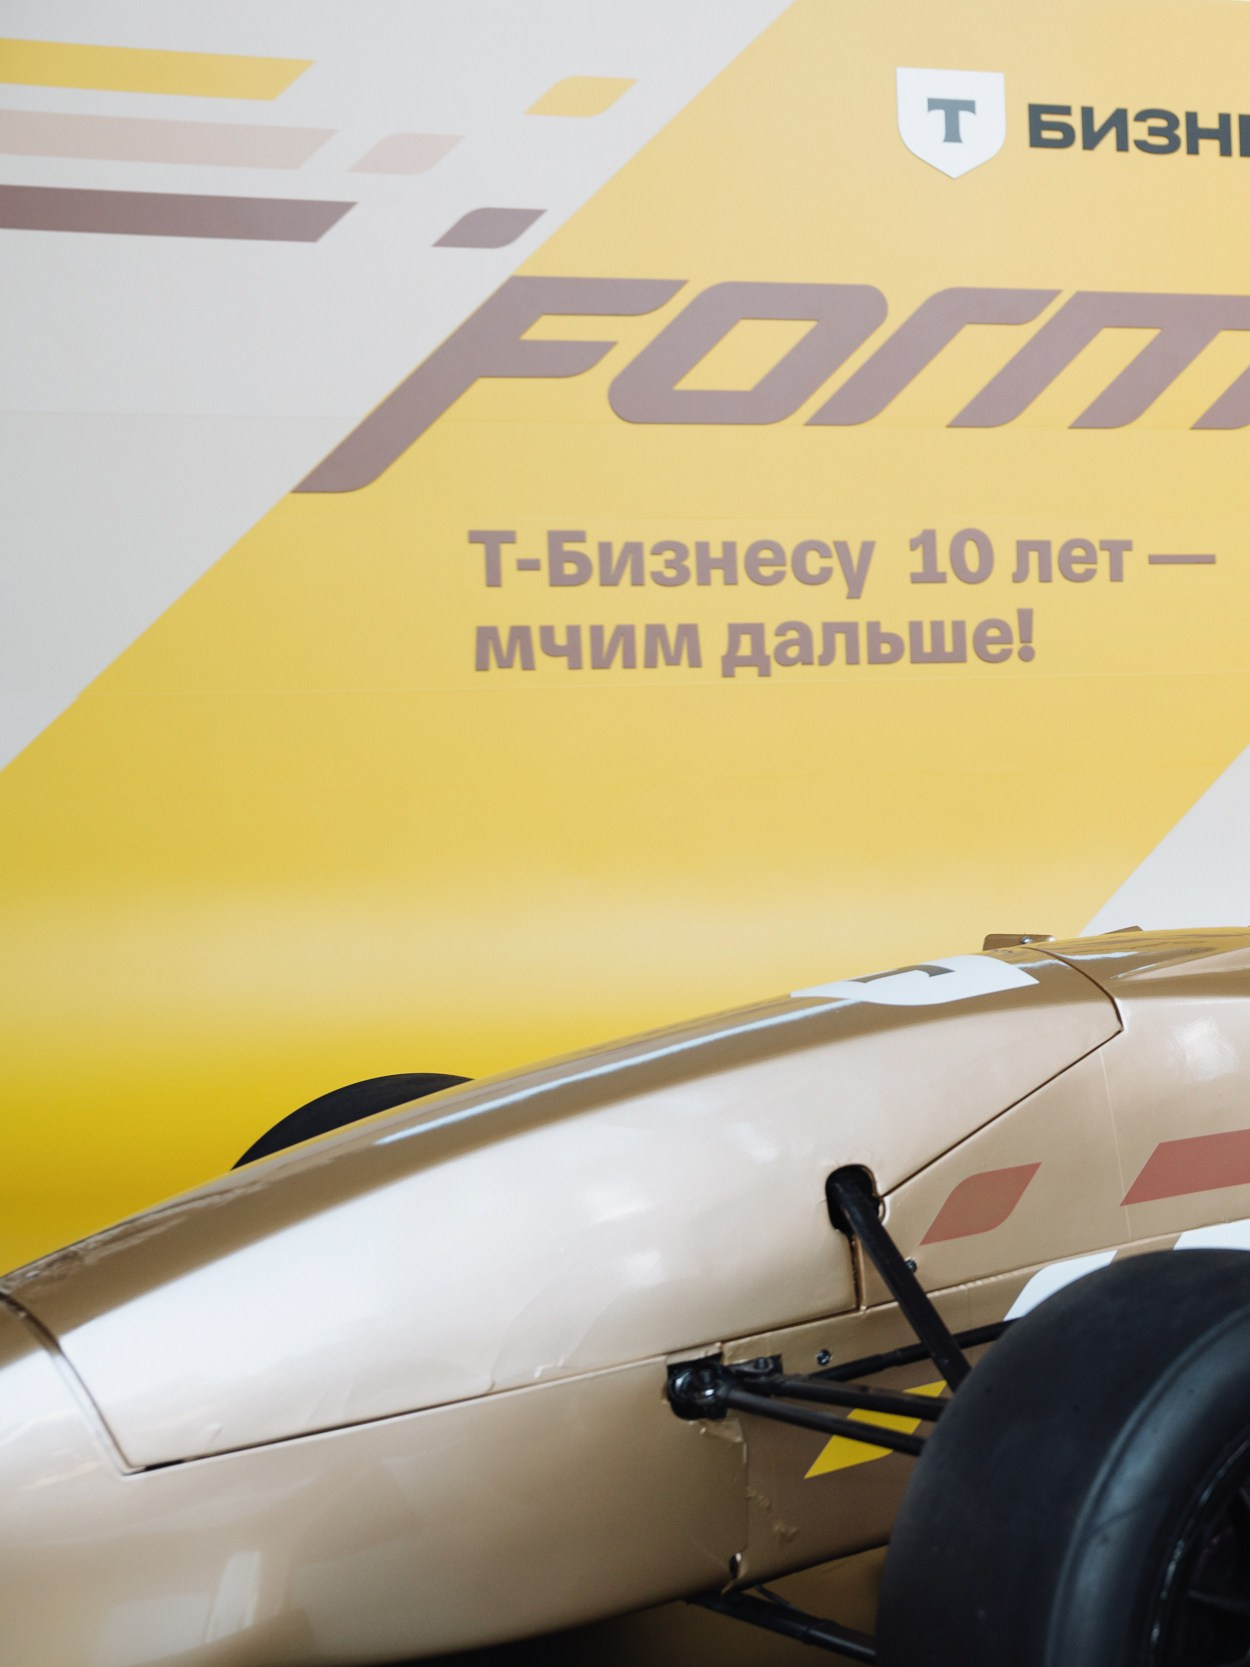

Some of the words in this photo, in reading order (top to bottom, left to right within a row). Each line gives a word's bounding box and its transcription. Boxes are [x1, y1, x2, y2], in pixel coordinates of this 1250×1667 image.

[468, 528, 876, 599] Т-Бизнесу
[908, 527, 994, 585] 10
[1012, 538, 1133, 583] лет
[475, 622, 702, 671] мчим
[721, 608, 1036, 677] дальше!
